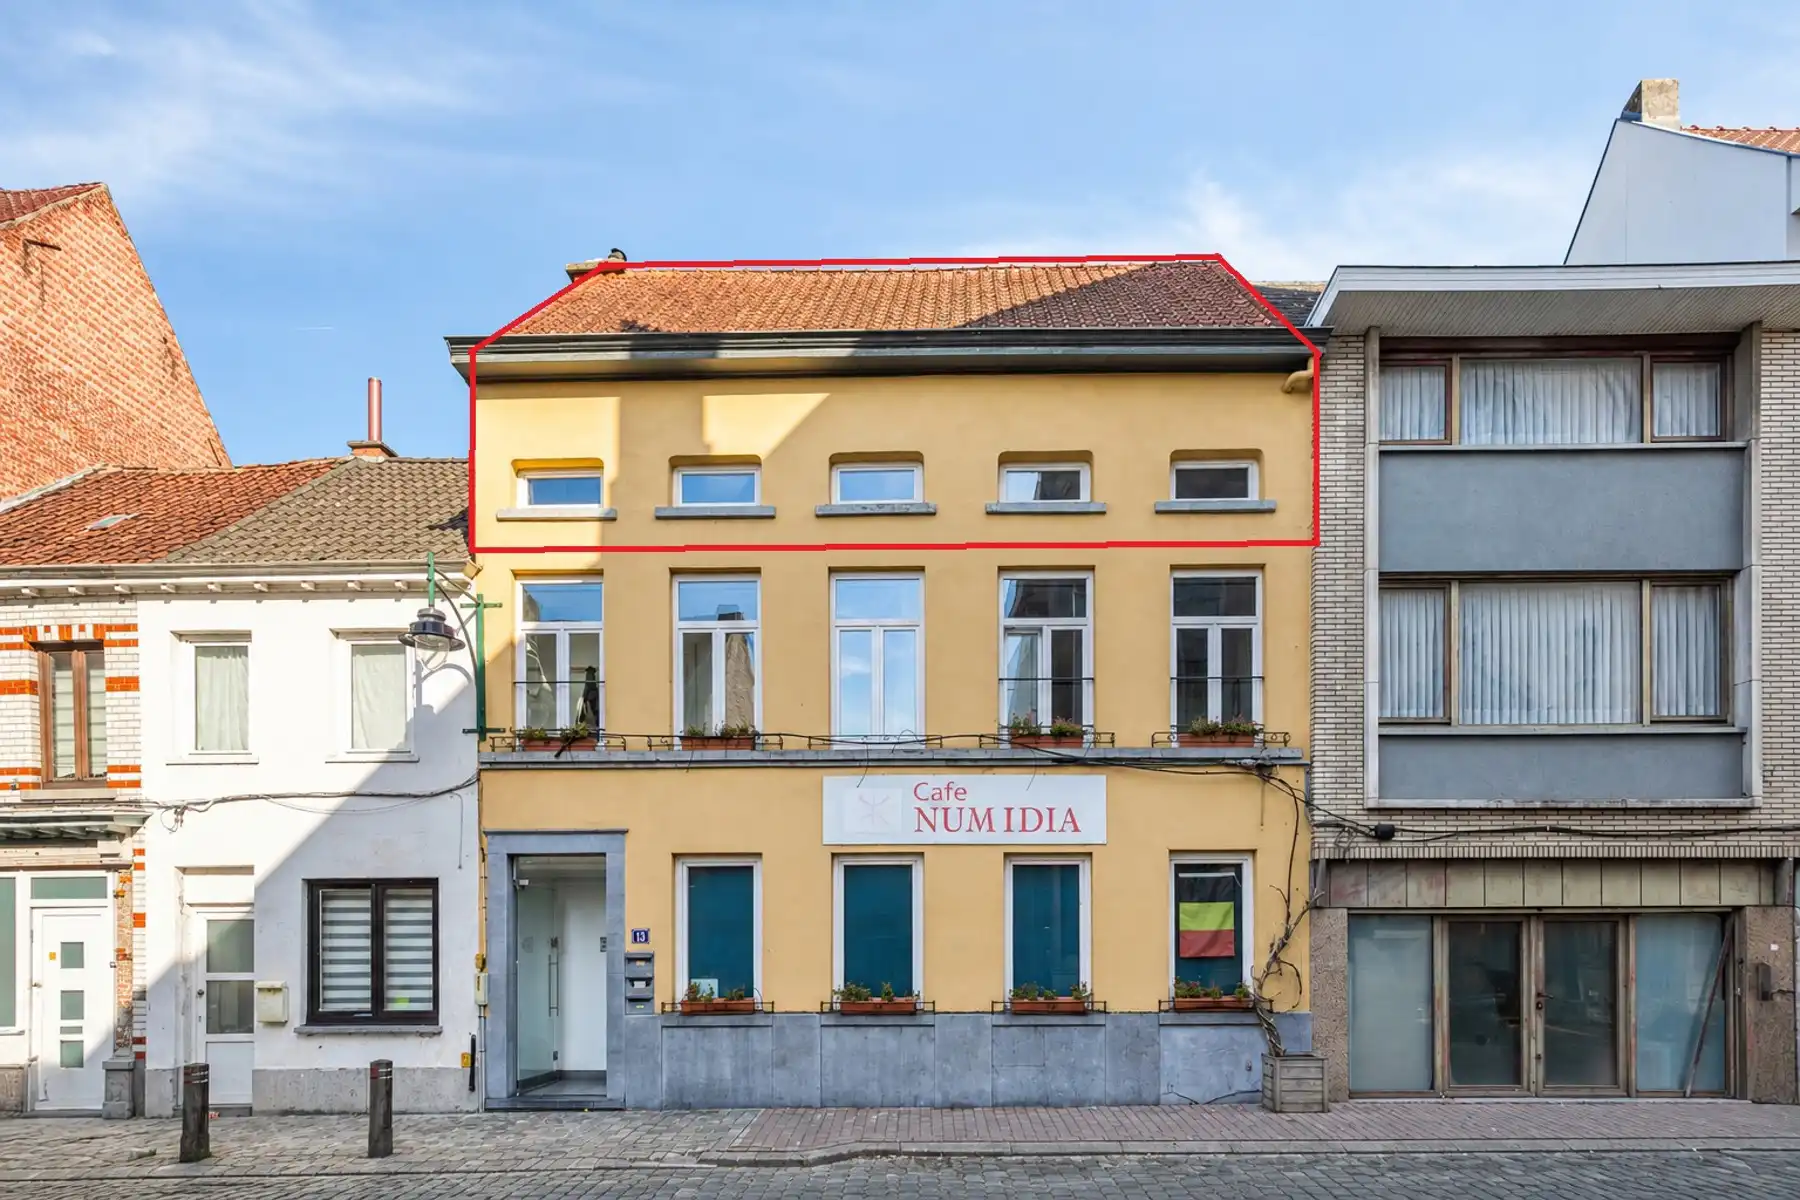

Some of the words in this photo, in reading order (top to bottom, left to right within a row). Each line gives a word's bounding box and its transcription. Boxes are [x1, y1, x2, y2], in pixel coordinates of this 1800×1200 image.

[913, 782, 967, 801] Cafe
[914, 807, 1082, 833] NUMIDIA
[636, 931, 646, 942] 13
